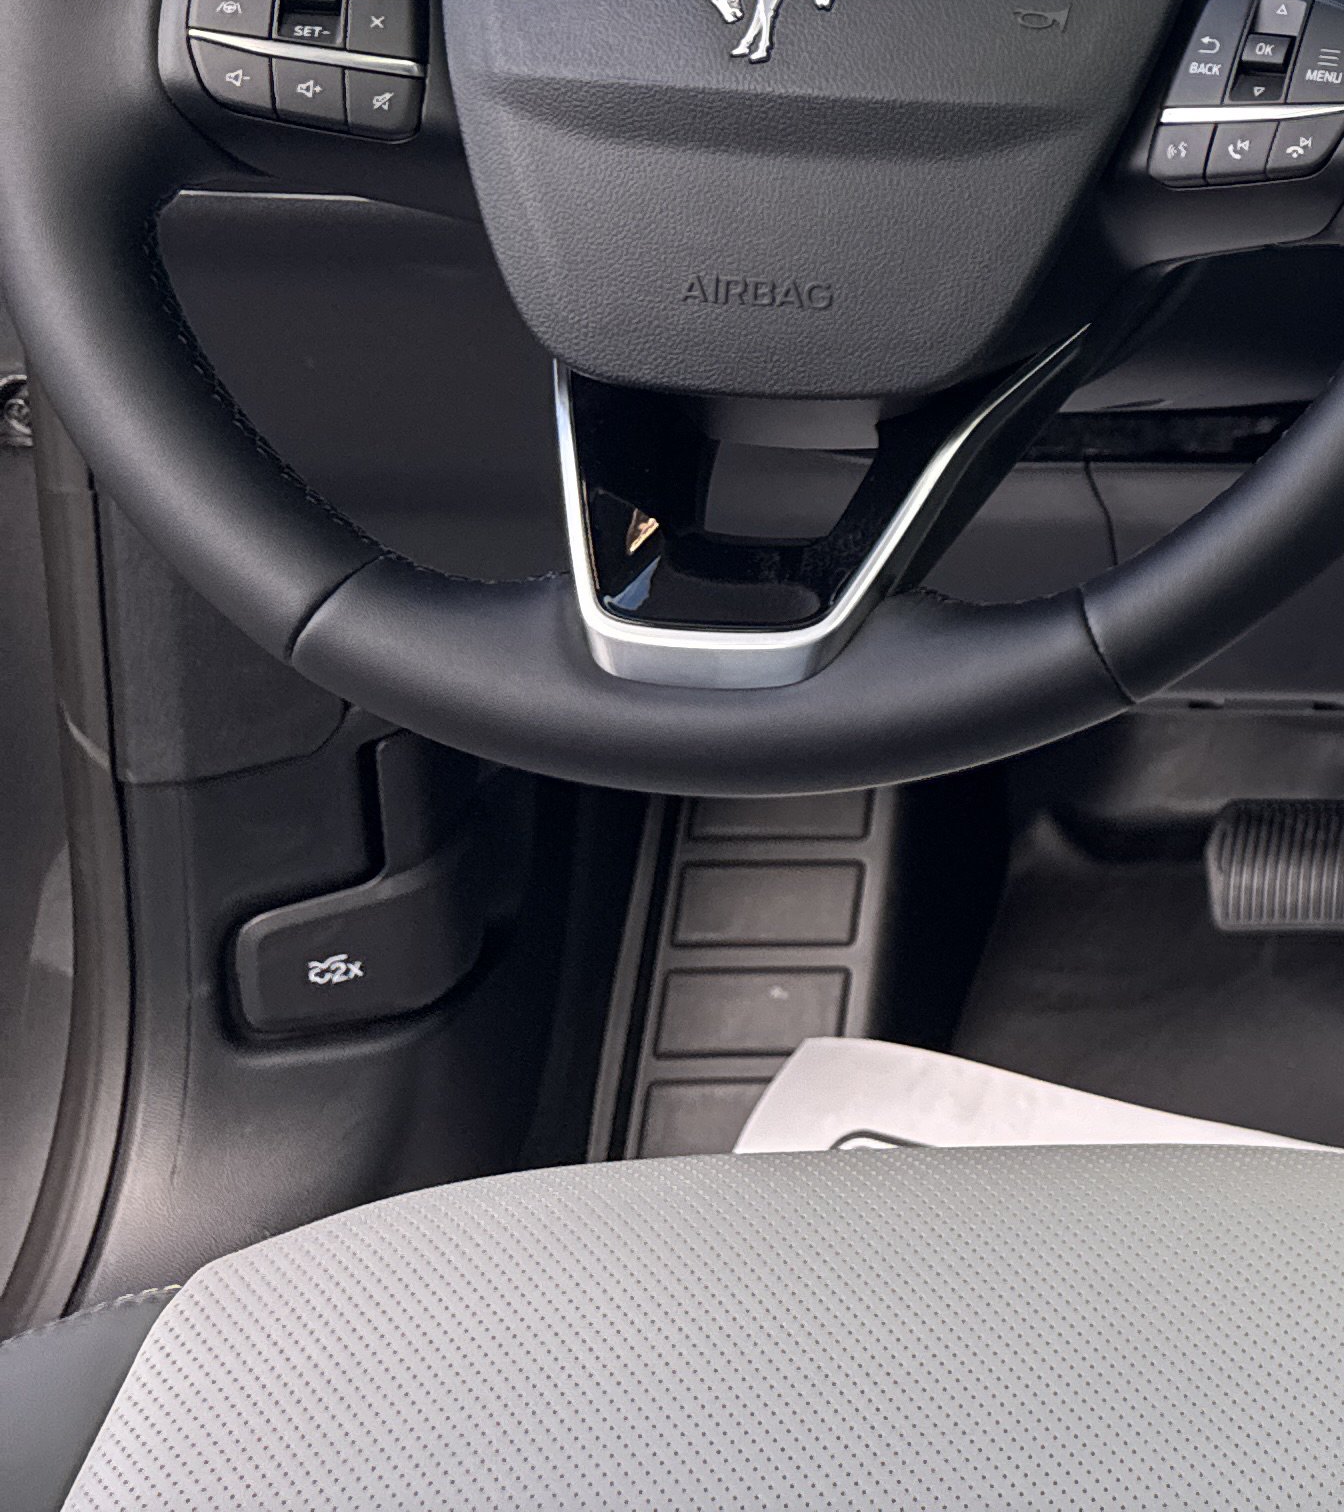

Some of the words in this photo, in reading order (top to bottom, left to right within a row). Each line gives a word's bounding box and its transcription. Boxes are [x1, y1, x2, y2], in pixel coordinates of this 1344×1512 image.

[1254, 42, 1274, 57] OK
[1189, 61, 1222, 76] BACK
[1305, 69, 1343, 84] MENU
[682, 272, 836, 311] AIRBAG
